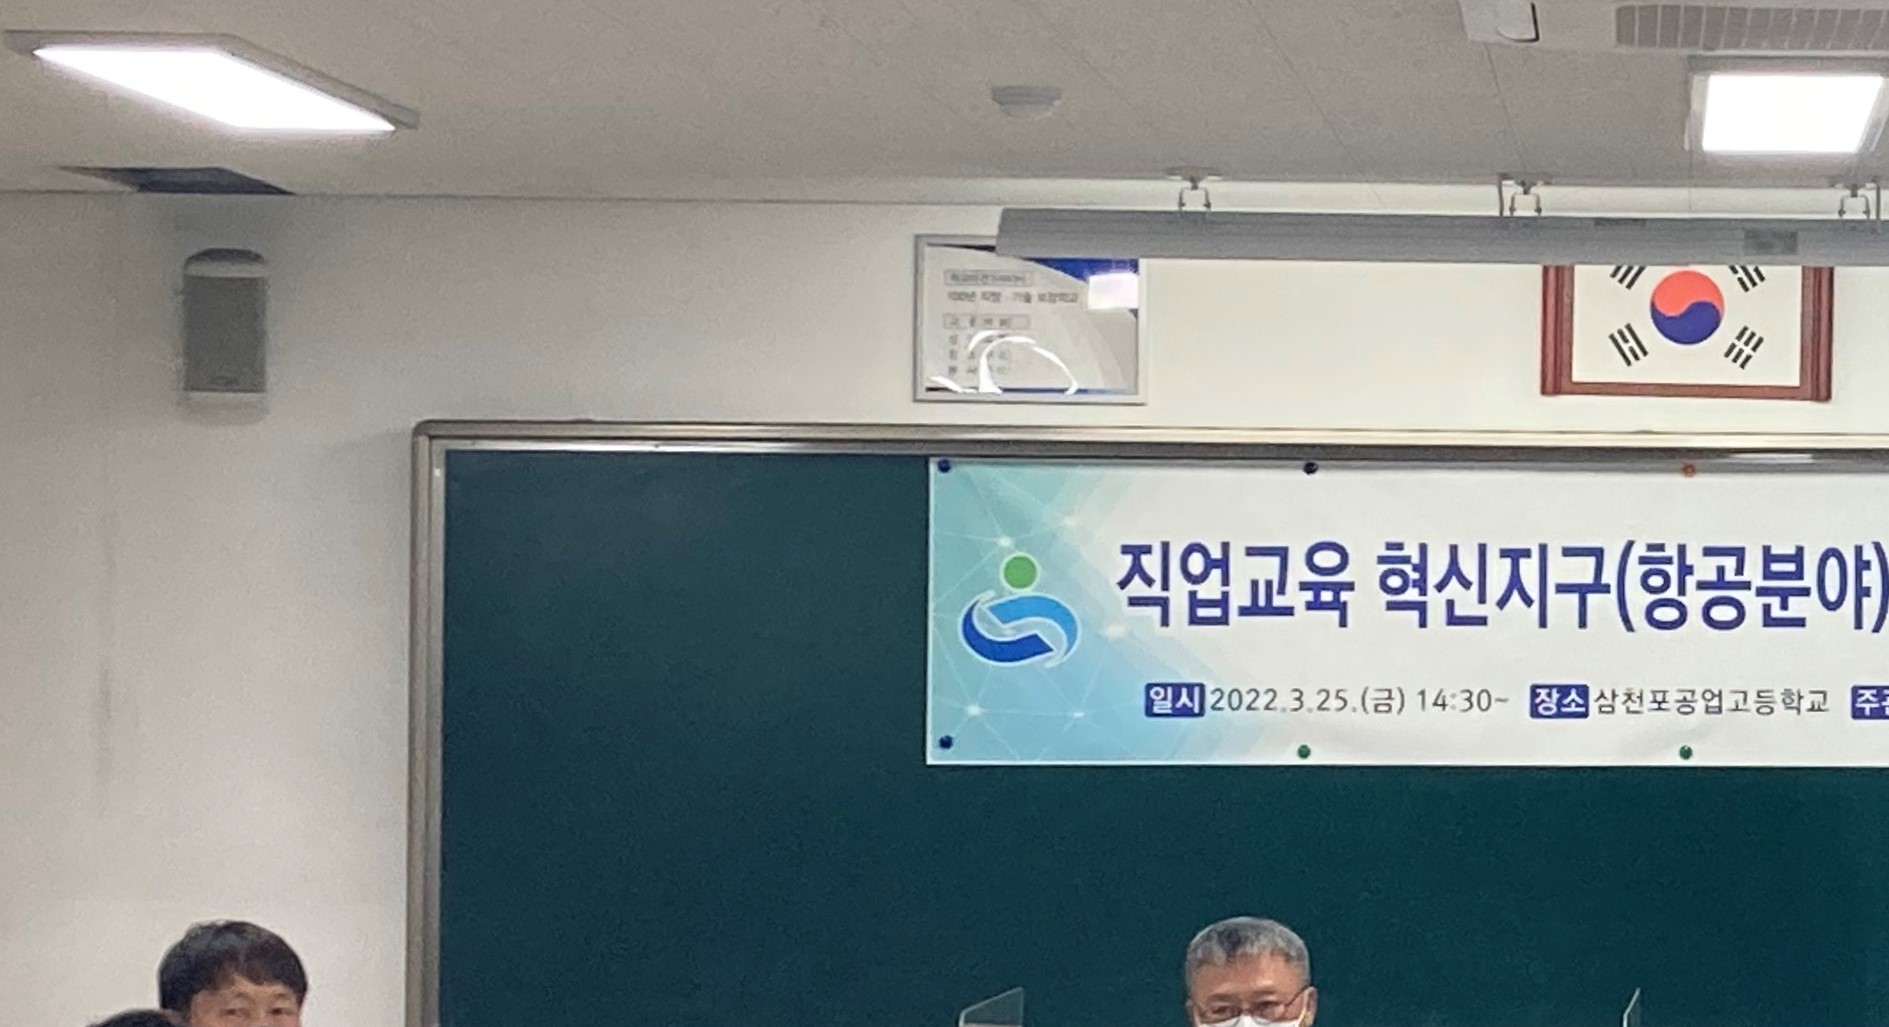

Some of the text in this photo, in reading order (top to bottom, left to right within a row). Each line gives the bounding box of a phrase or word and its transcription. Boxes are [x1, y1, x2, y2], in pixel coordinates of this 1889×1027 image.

[1116, 541, 1355, 628] 직업교육
[1376, 540, 1889, 633] 혁신지구(항공분야)
[1149, 685, 1510, 715] 일시 2022.3.25.(금) 14:30~
[1534, 687, 1830, 716] 장소 삼천포공업고등학교
